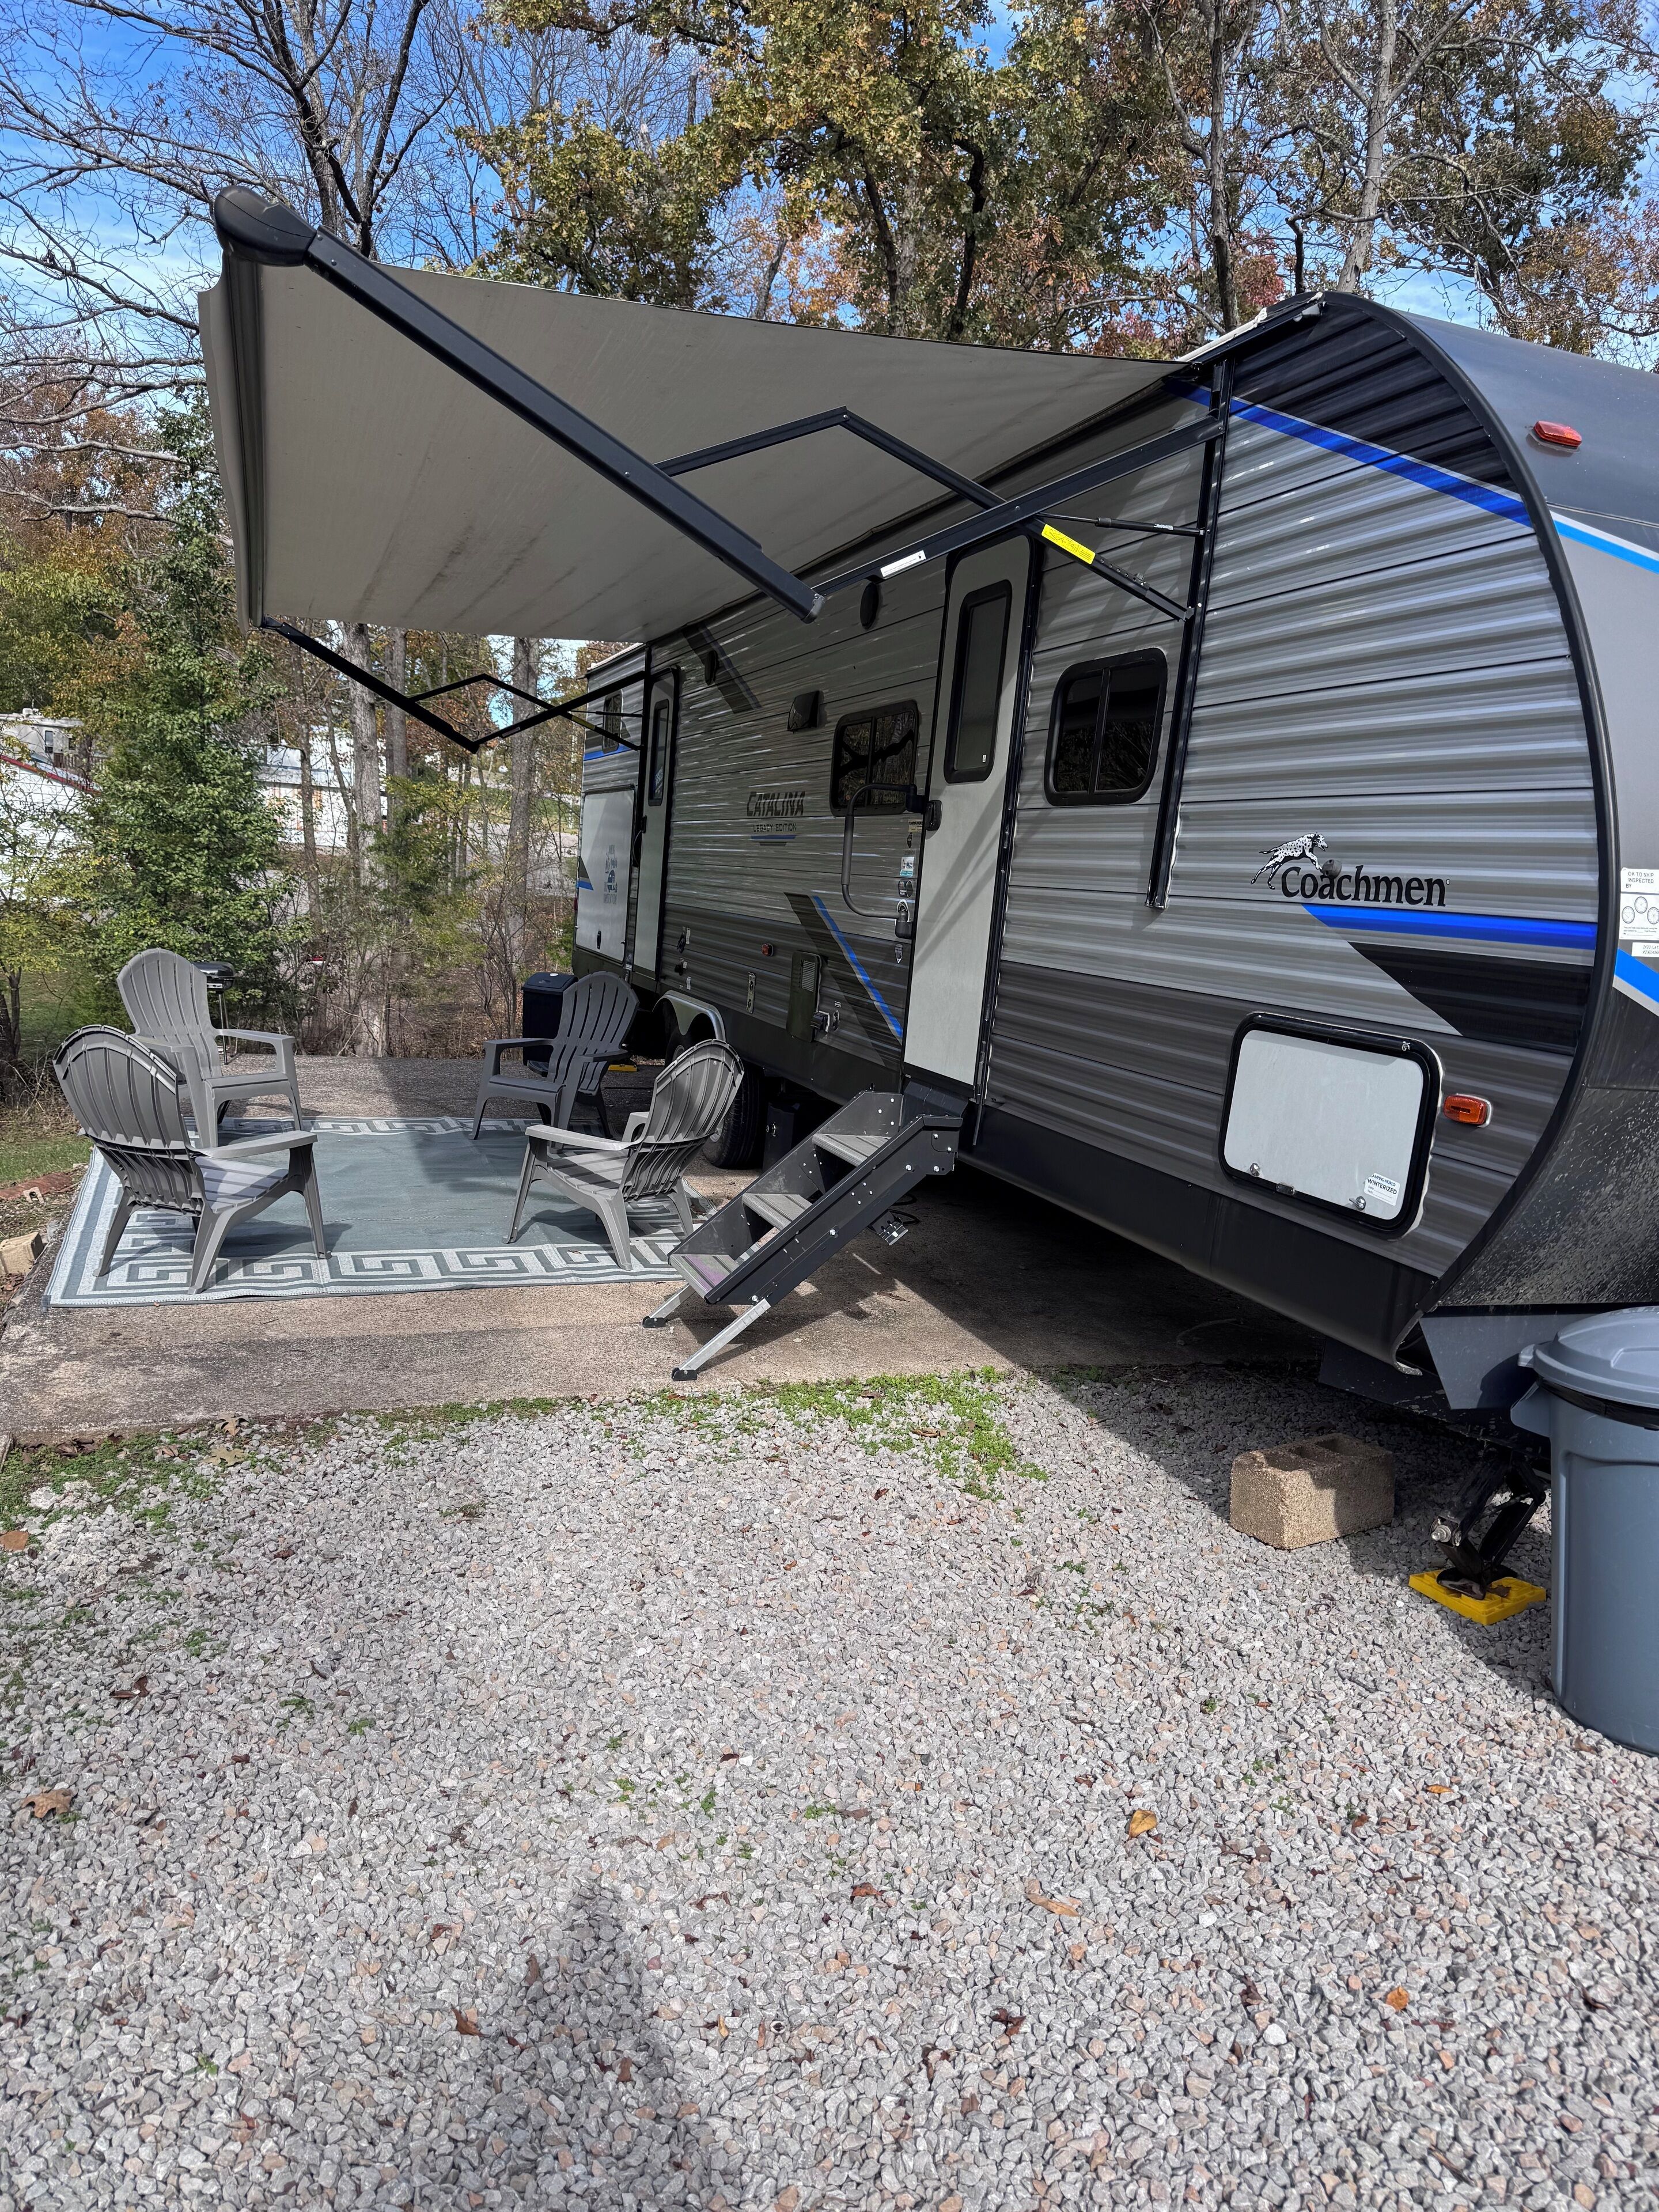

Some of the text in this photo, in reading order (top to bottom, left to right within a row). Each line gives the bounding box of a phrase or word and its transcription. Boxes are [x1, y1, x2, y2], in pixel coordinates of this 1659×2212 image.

[747, 791, 805, 816] CATALINA
[753, 823, 797, 832] LEGACY EDITION
[1281, 865, 1446, 907] Coachmen
[1367, 1178, 1397, 1195] WINTERIZED
[1371, 1174, 1385, 1182] AMPING
